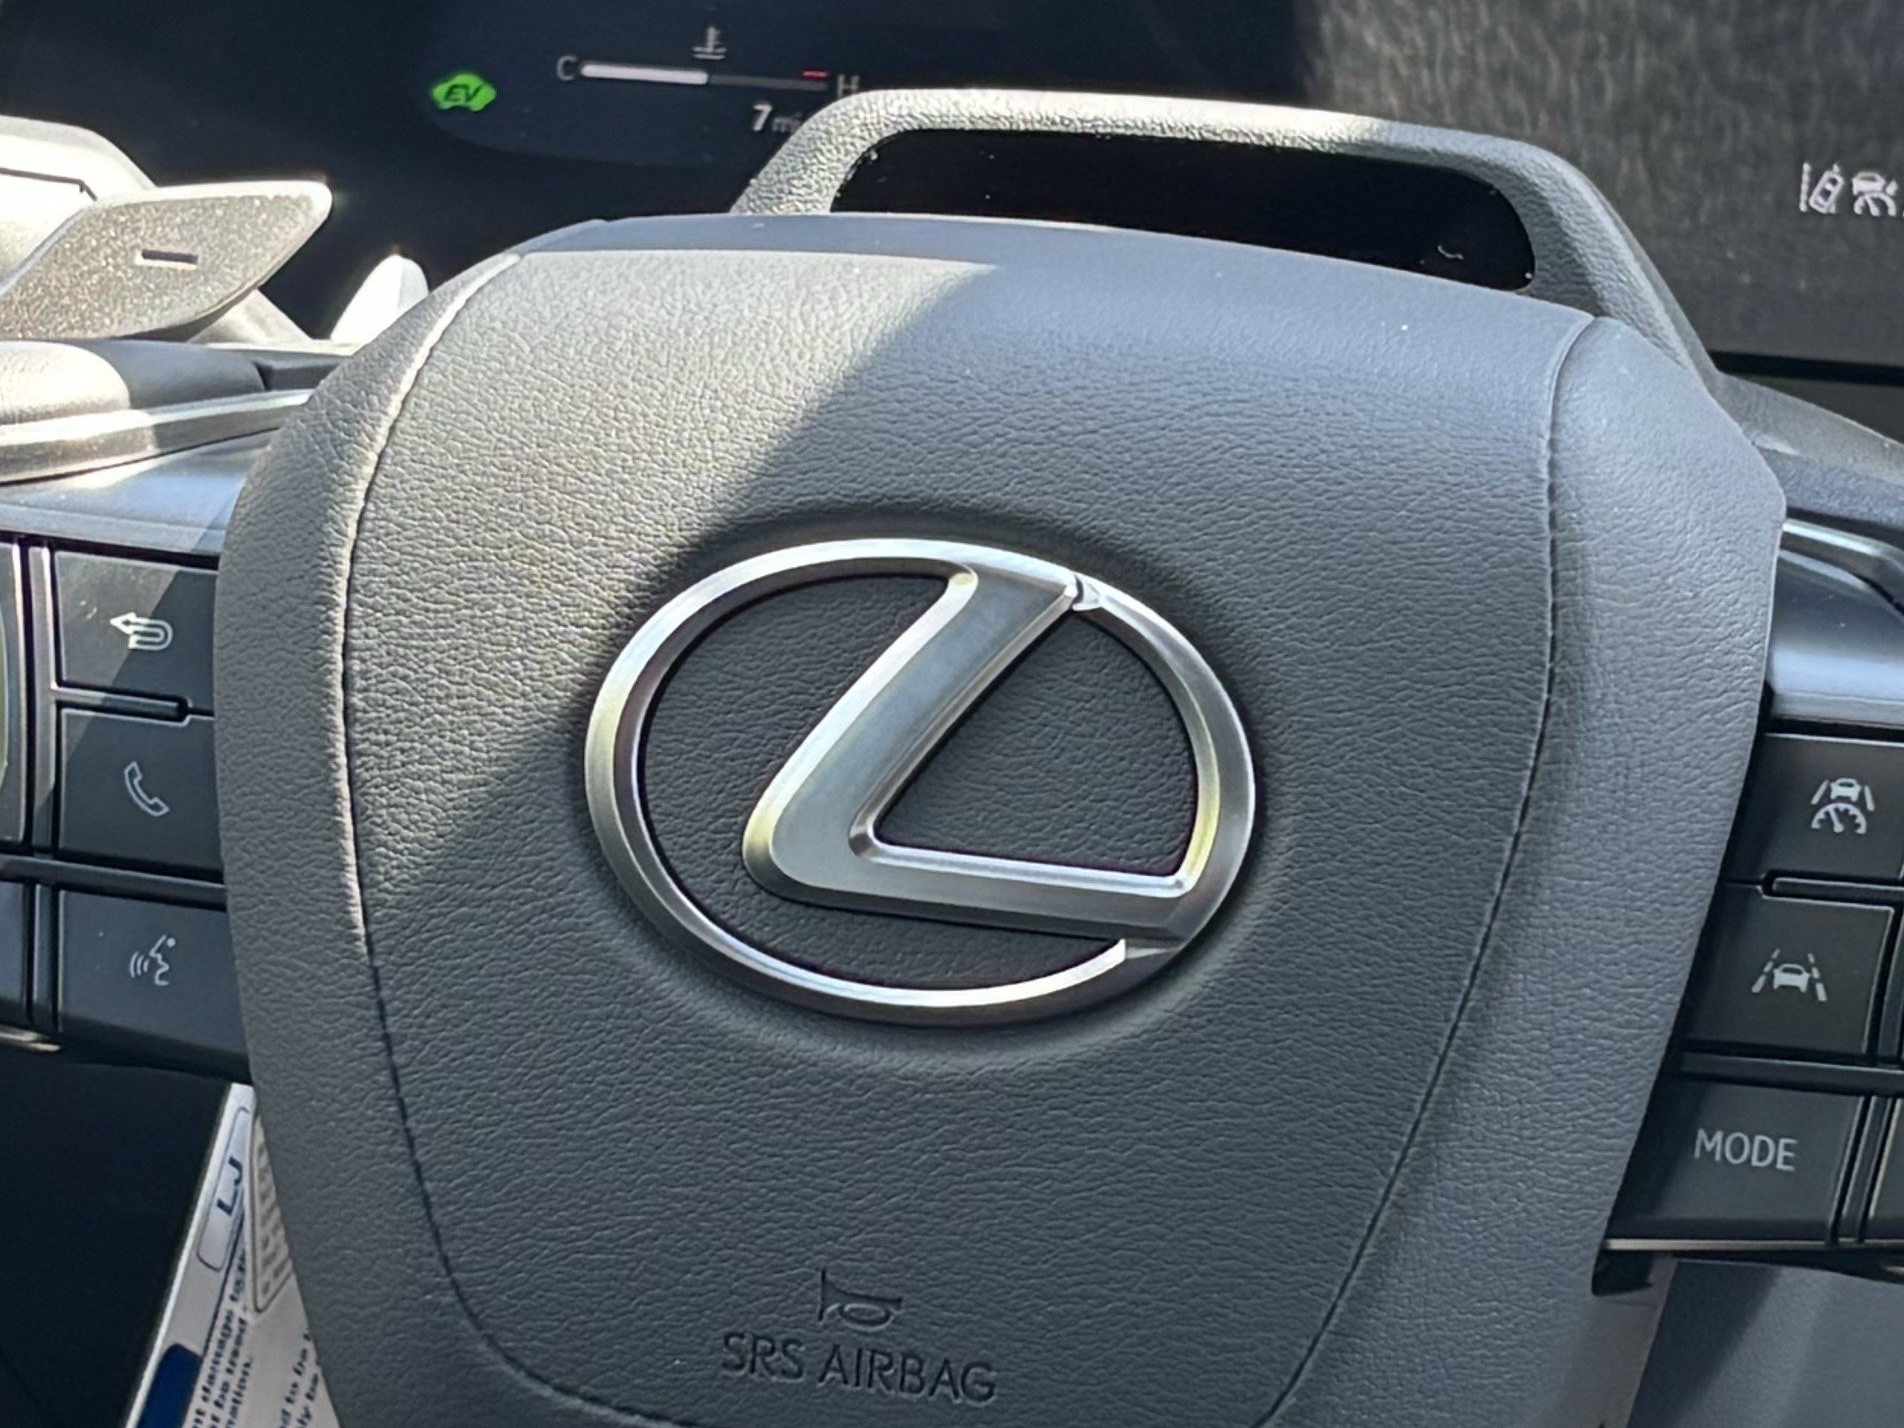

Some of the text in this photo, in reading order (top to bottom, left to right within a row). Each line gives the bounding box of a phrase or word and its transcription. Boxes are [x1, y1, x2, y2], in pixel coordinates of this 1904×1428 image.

[556, 56, 578, 81] C
[443, 84, 483, 104] EV
[752, 102, 774, 132] 7
[1694, 1128, 1799, 1173] MODE
[721, 1330, 998, 1404] SRS AIRBAG
